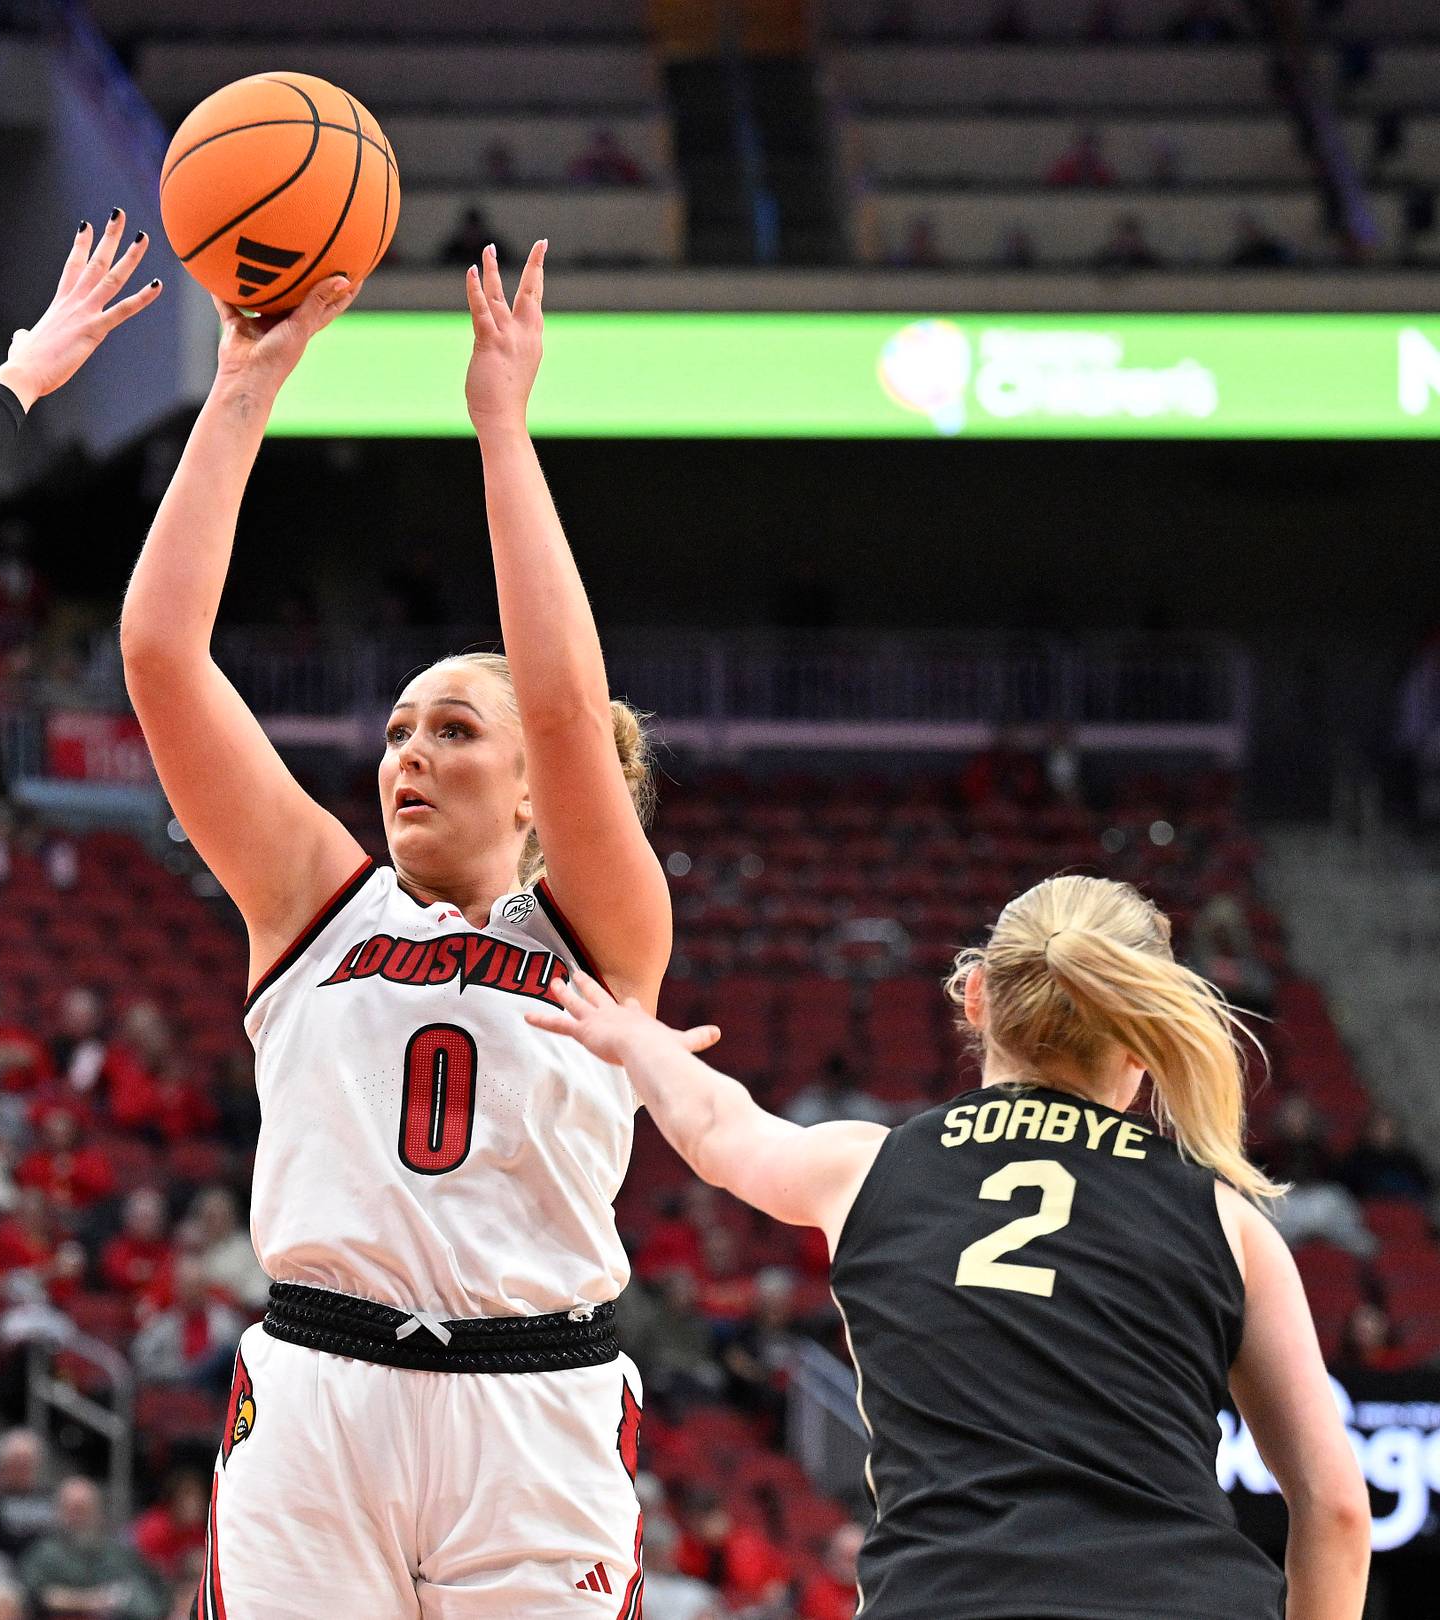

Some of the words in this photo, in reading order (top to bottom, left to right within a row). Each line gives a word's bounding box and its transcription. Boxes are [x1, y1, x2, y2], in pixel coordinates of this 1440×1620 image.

[398, 1023, 477, 1175] 0
[941, 1099, 1153, 1160] SORBYE
[955, 1159, 1077, 1298] 2
